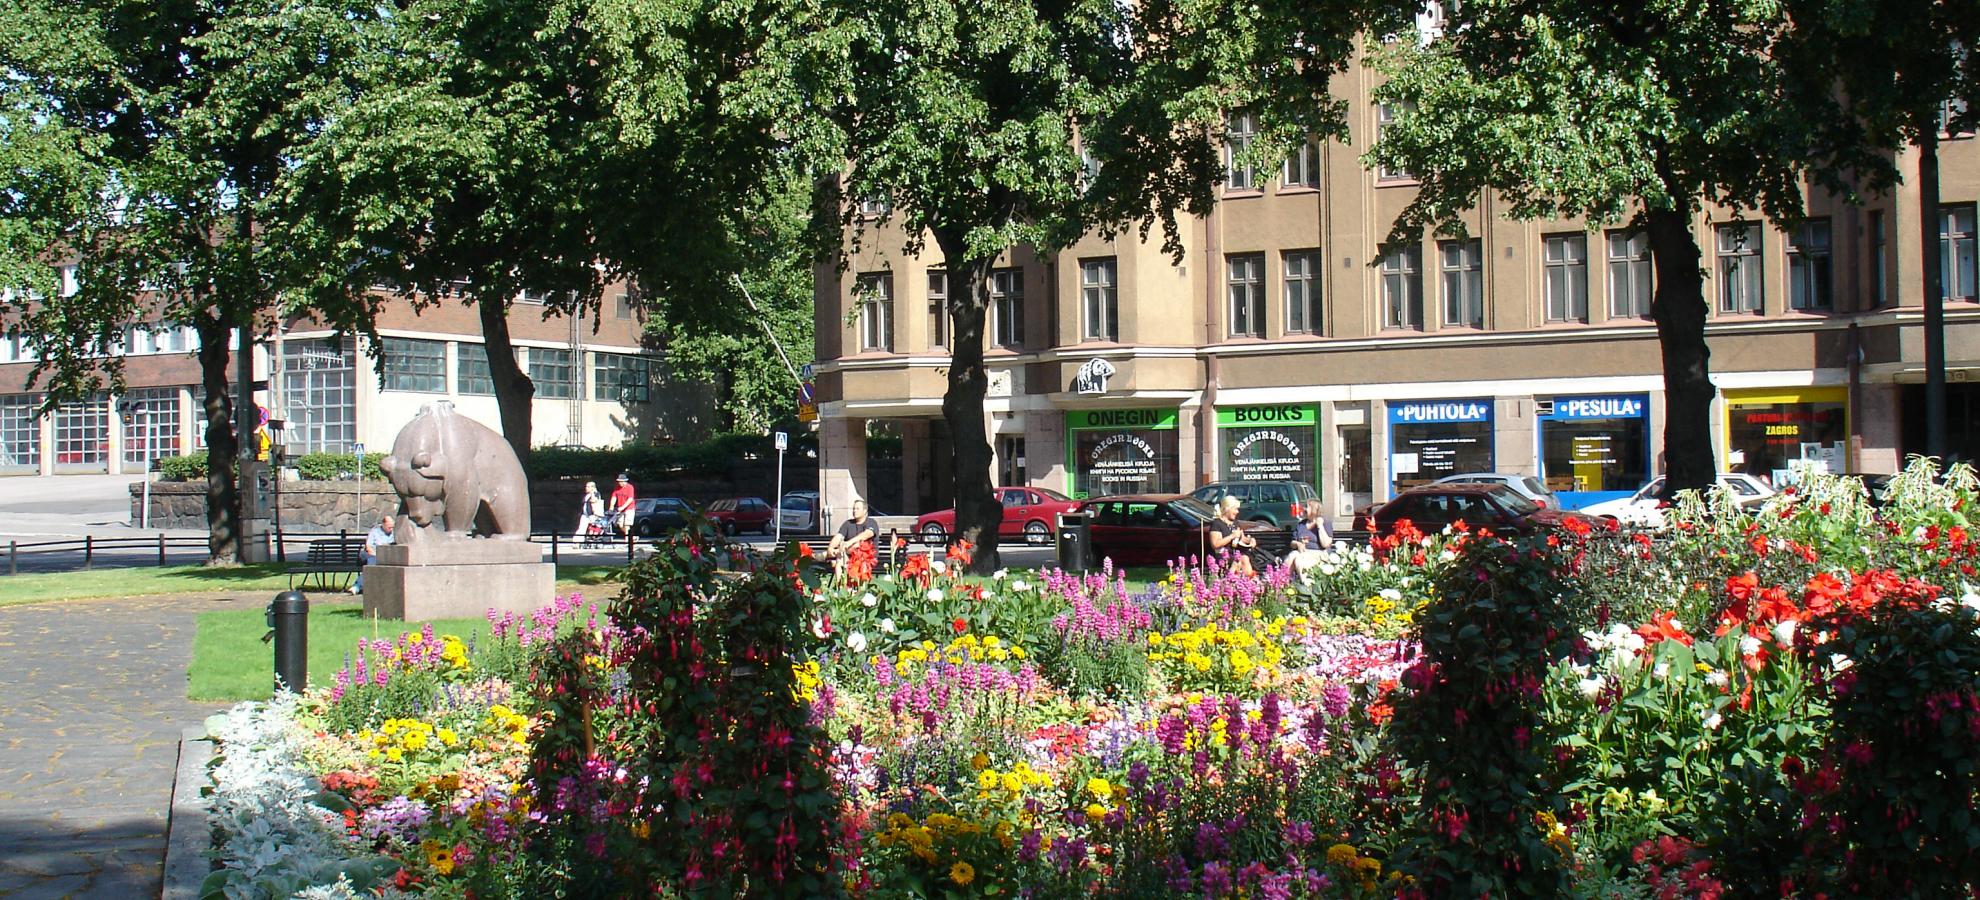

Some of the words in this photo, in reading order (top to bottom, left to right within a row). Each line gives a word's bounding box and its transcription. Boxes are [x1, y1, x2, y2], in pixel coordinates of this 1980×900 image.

[1235, 406, 1303, 421] BOOKS
[1404, 403, 1480, 420] PUHTOLA
[1568, 399, 1634, 416] PESULA
[1088, 410, 1158, 425] ONEGIN
[1765, 426, 1799, 435] ZAGROS
